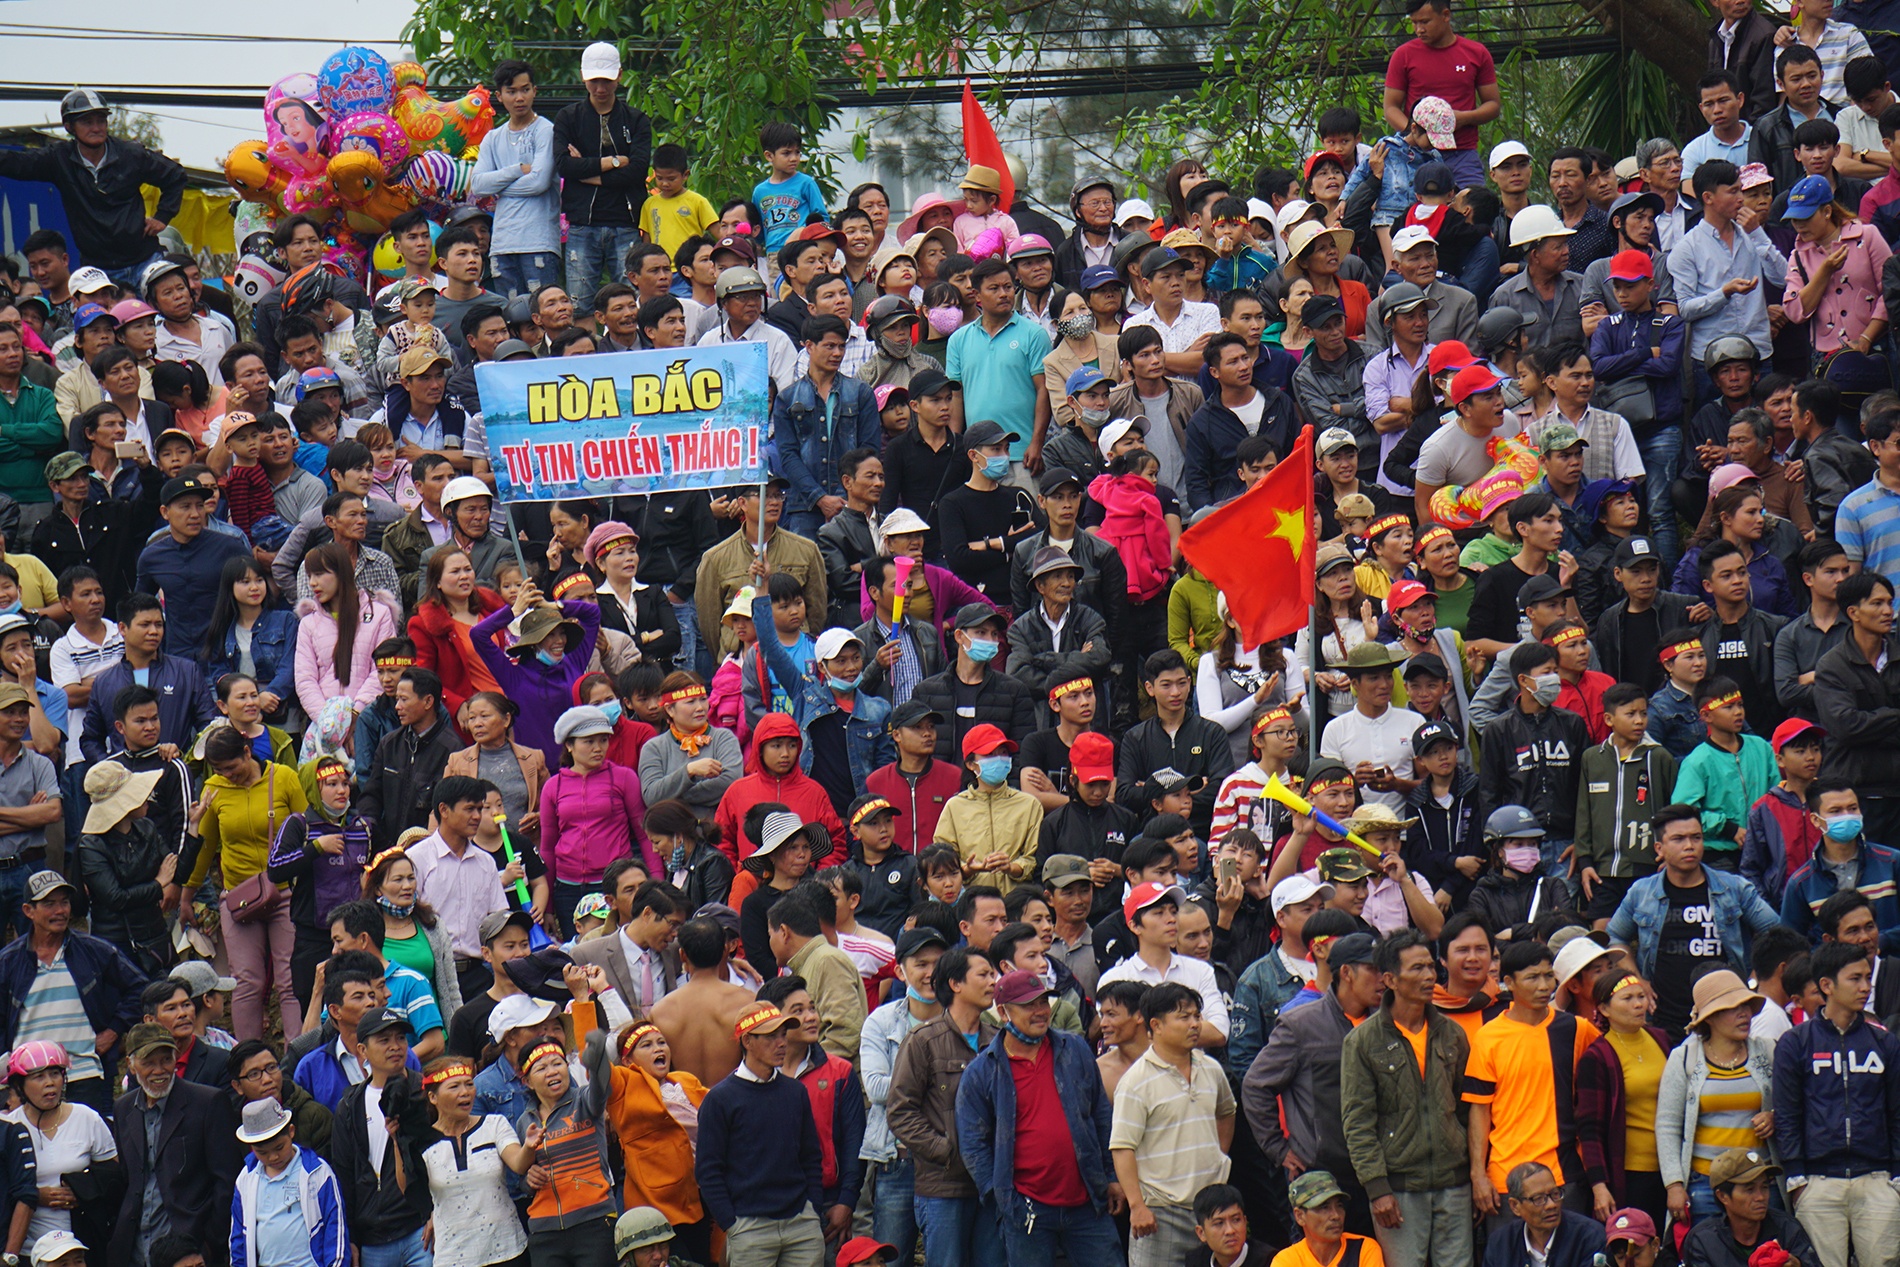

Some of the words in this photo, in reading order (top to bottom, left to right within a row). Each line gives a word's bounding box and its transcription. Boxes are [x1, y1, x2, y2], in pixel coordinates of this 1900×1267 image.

[527, 373, 622, 425] HÒA
[631, 361, 723, 416] BẮC
[500, 438, 534, 493] TỰ
[534, 443, 579, 485] TIN
[581, 423, 664, 481] CHIẾN
[664, 418, 742, 476] THẮNG
[747, 427, 760, 468] !
[1420, 724, 1441, 740] FILA
[1515, 741, 1571, 767] FILA
[1107, 831, 1125, 842] FILA
[1813, 1050, 1885, 1074] FILA
